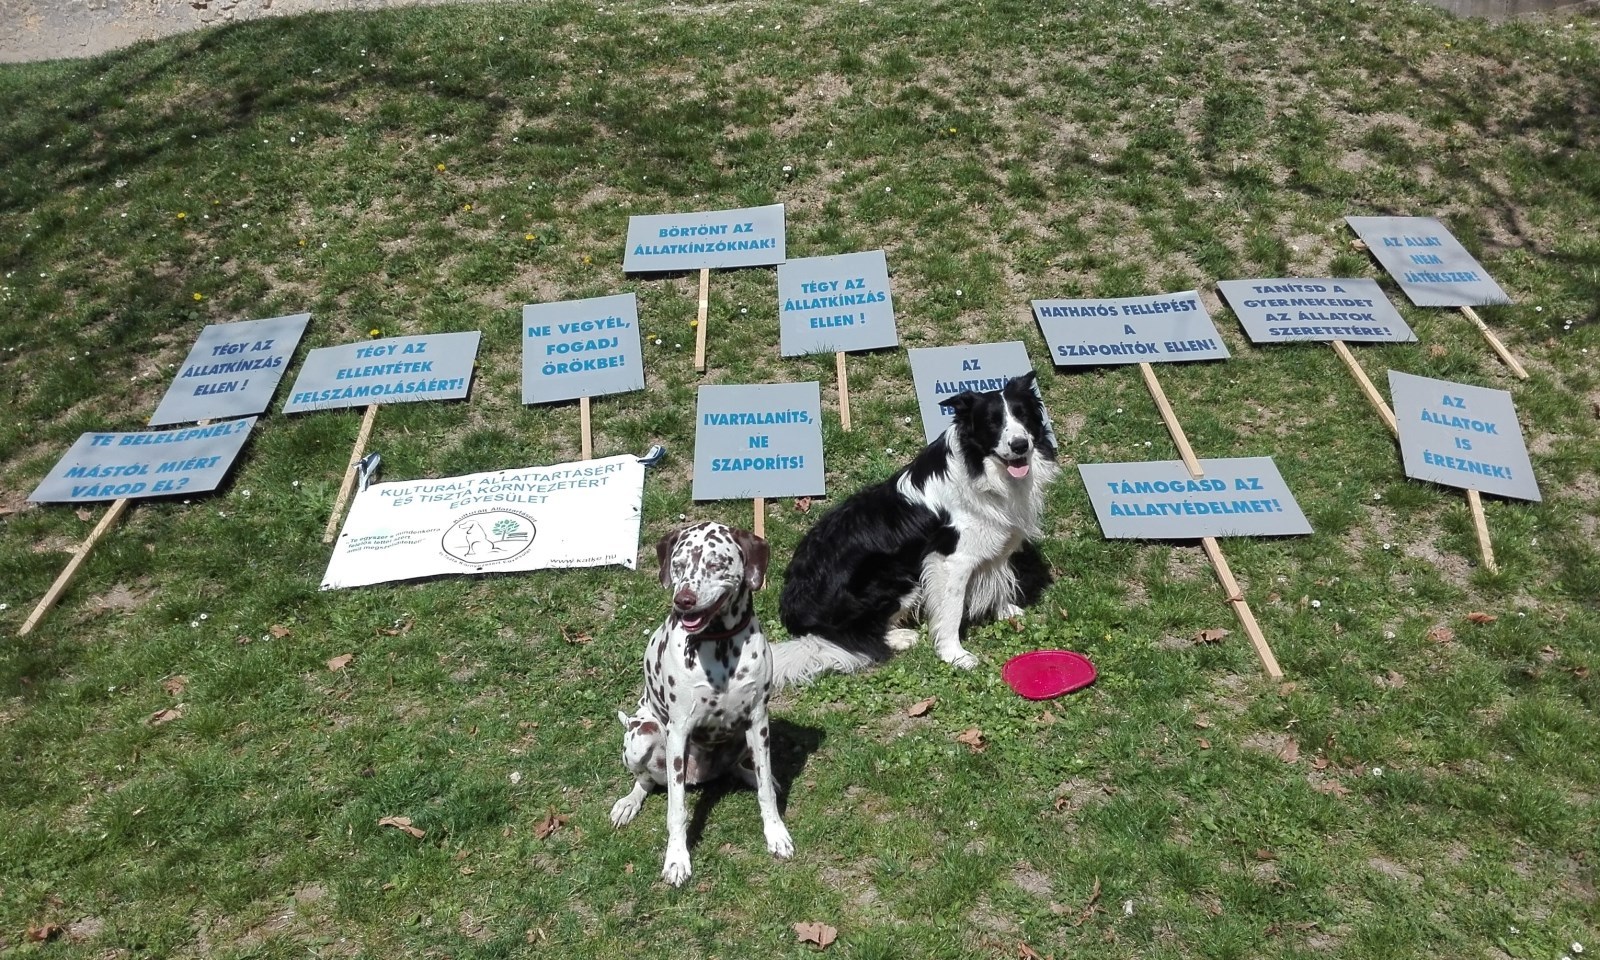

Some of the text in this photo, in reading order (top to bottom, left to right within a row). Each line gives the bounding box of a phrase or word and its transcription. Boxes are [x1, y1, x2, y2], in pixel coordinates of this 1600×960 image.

[659, 223, 753, 237] BÖRTÖNT AZ
[634, 238, 776, 255] ÁLLATKÍNZÓKNAK!
[1383, 235, 1442, 246] AZ ÁLLAT
[1409, 254, 1443, 264] NEM
[1404, 271, 1480, 282] JÁTÉKSZER!
[801, 278, 865, 293] TÉGY AZ
[1252, 284, 1326, 293] TANÍTSD
[784, 291, 886, 311] ÁLLATKÍNZÁS
[1040, 299, 1198, 317] HATHATÓS FELLÉPÉST
[810, 315, 854, 328] ELLEN
[1266, 311, 1377, 321] AZ ÁLLATOK
[528, 315, 631, 338] NE VEGYÉL,
[1124, 325, 1136, 334] A
[1269, 326, 1393, 336] SZERETETÉRE!
[213, 340, 275, 355] TÉGY AZ
[356, 343, 426, 359] TÉGY AZ
[546, 337, 619, 355] FOGADJ
[1057, 339, 1218, 356] SZAPORÍTÓK ELLEN!
[181, 356, 283, 378] ÁLLATKÍNZÁS
[336, 360, 433, 380] ELLENTÉTEK
[542, 355, 626, 376] ÖRÖKBE!
[963, 359, 981, 371] AZ
[193, 381, 238, 396] ELLEN
[293, 378, 465, 404] FELSZÁMOLÁSÁÉRT!
[1442, 395, 1466, 409] AZ
[703, 408, 814, 426] IVARTALANÍTS,
[1421, 408, 1498, 435] ÁLLATOK
[91, 421, 247, 446] TE BELELÉPNÉL?
[749, 435, 769, 449] NE
[1455, 437, 1472, 450] IS
[63, 456, 221, 479] MÁSTÓL MIÉRT
[712, 455, 804, 472] SZAPORÍTS!
[1423, 449, 1513, 480] ÉREZNEK!
[71, 477, 190, 498] VÁROD EL?
[381, 462, 625, 497] KULTURÁLT ÁLLATTARTÁSÉRT
[1108, 478, 1264, 495] TÁMOGASD AZ
[420, 490, 473, 503] TISZTA
[450, 492, 548, 510] EGYESÜLET
[1111, 499, 1283, 517] ÁLLATVÉDELMET!
